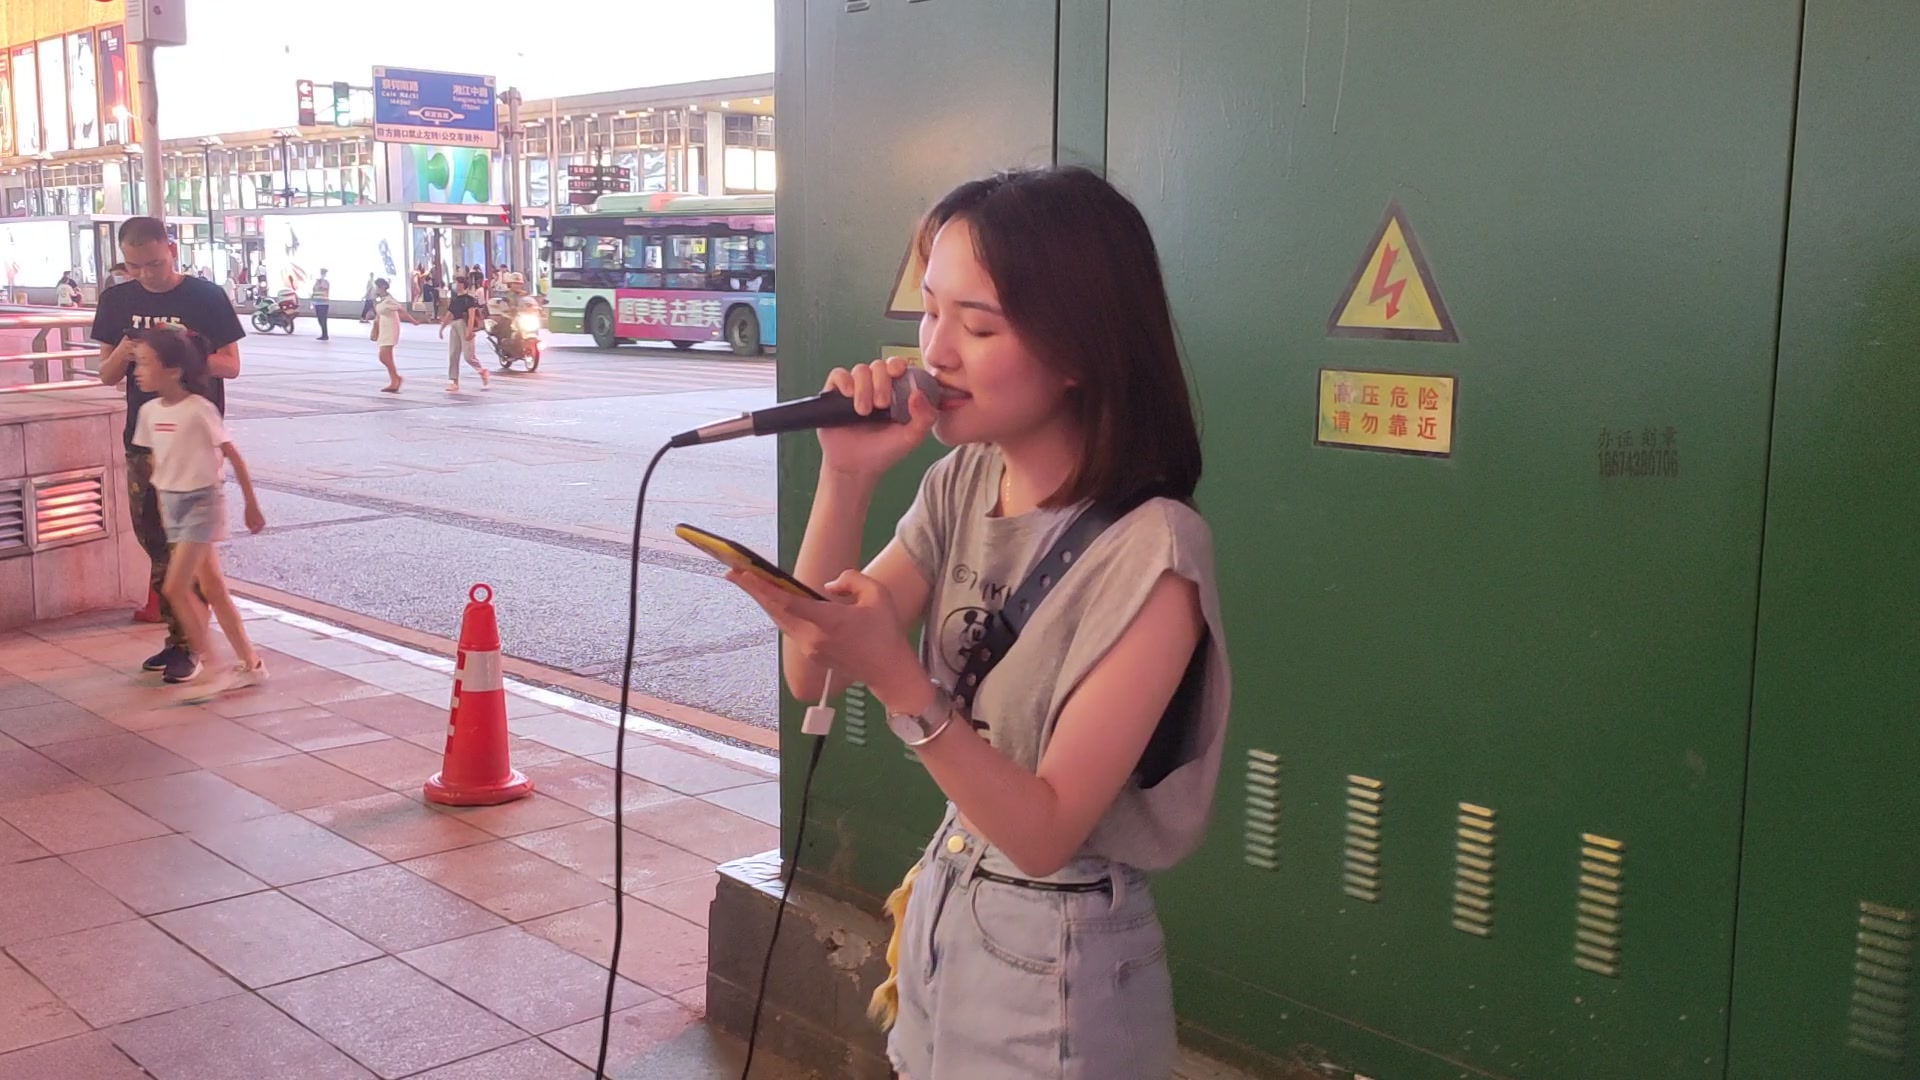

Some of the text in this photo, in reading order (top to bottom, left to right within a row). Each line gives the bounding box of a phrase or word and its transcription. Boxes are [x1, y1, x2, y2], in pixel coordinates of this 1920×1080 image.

[1333, 381, 1439, 411] 高压危险
[1332, 409, 1438, 441] 请勿靠近
